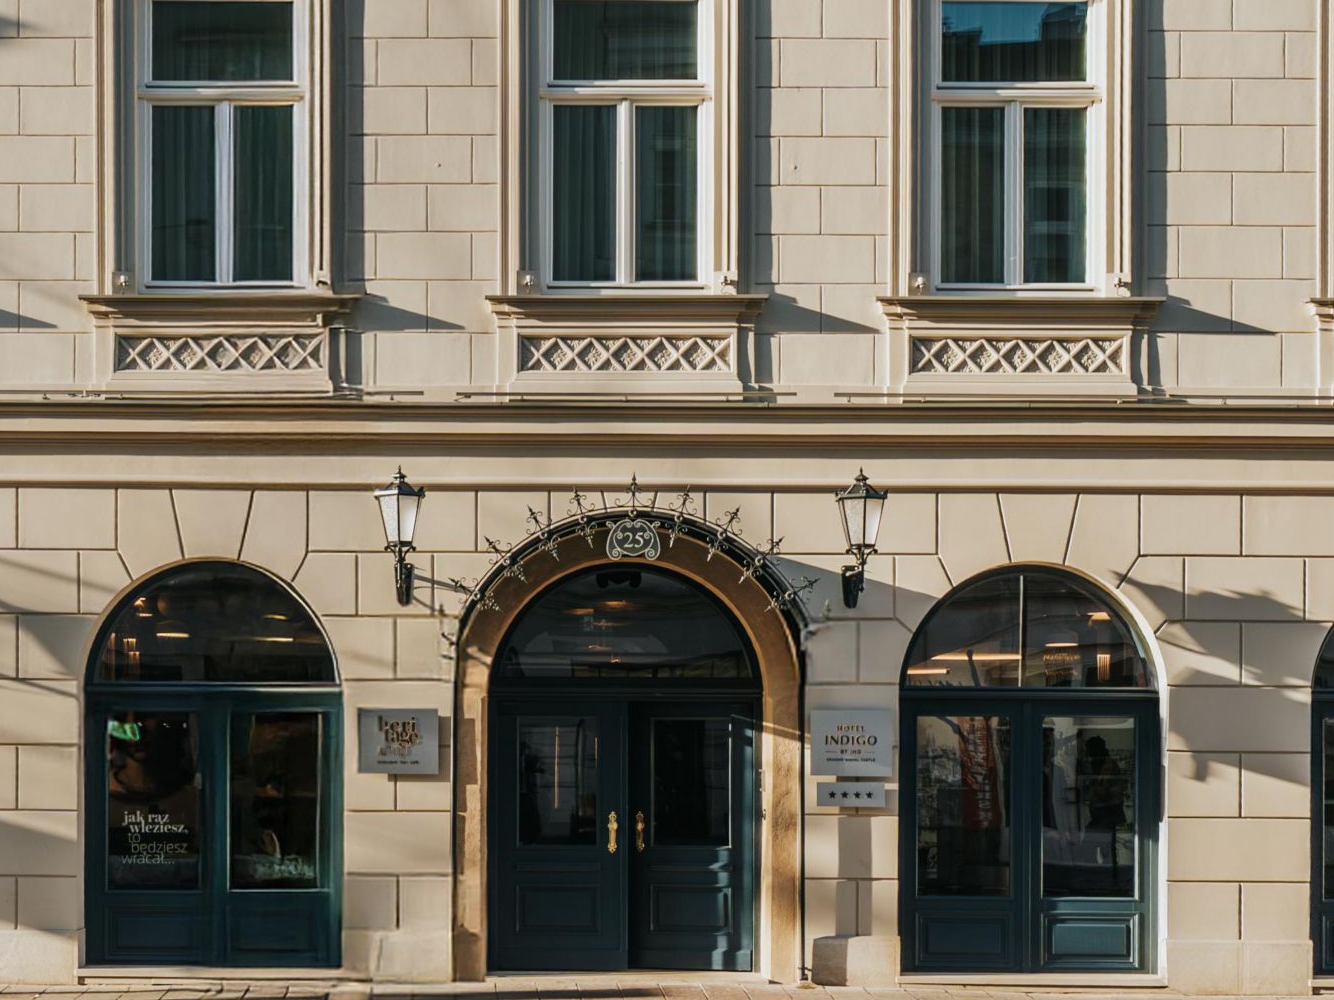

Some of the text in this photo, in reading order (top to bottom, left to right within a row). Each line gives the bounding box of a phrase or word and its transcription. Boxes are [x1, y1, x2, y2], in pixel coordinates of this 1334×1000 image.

[623, 532, 644, 548] 25
[836, 725, 864, 733] HOTEL
[825, 735, 878, 747] INDIGO
[122, 810, 169, 826] jak raz
[128, 832, 141, 843] to
[131, 841, 188, 856] będziesz
